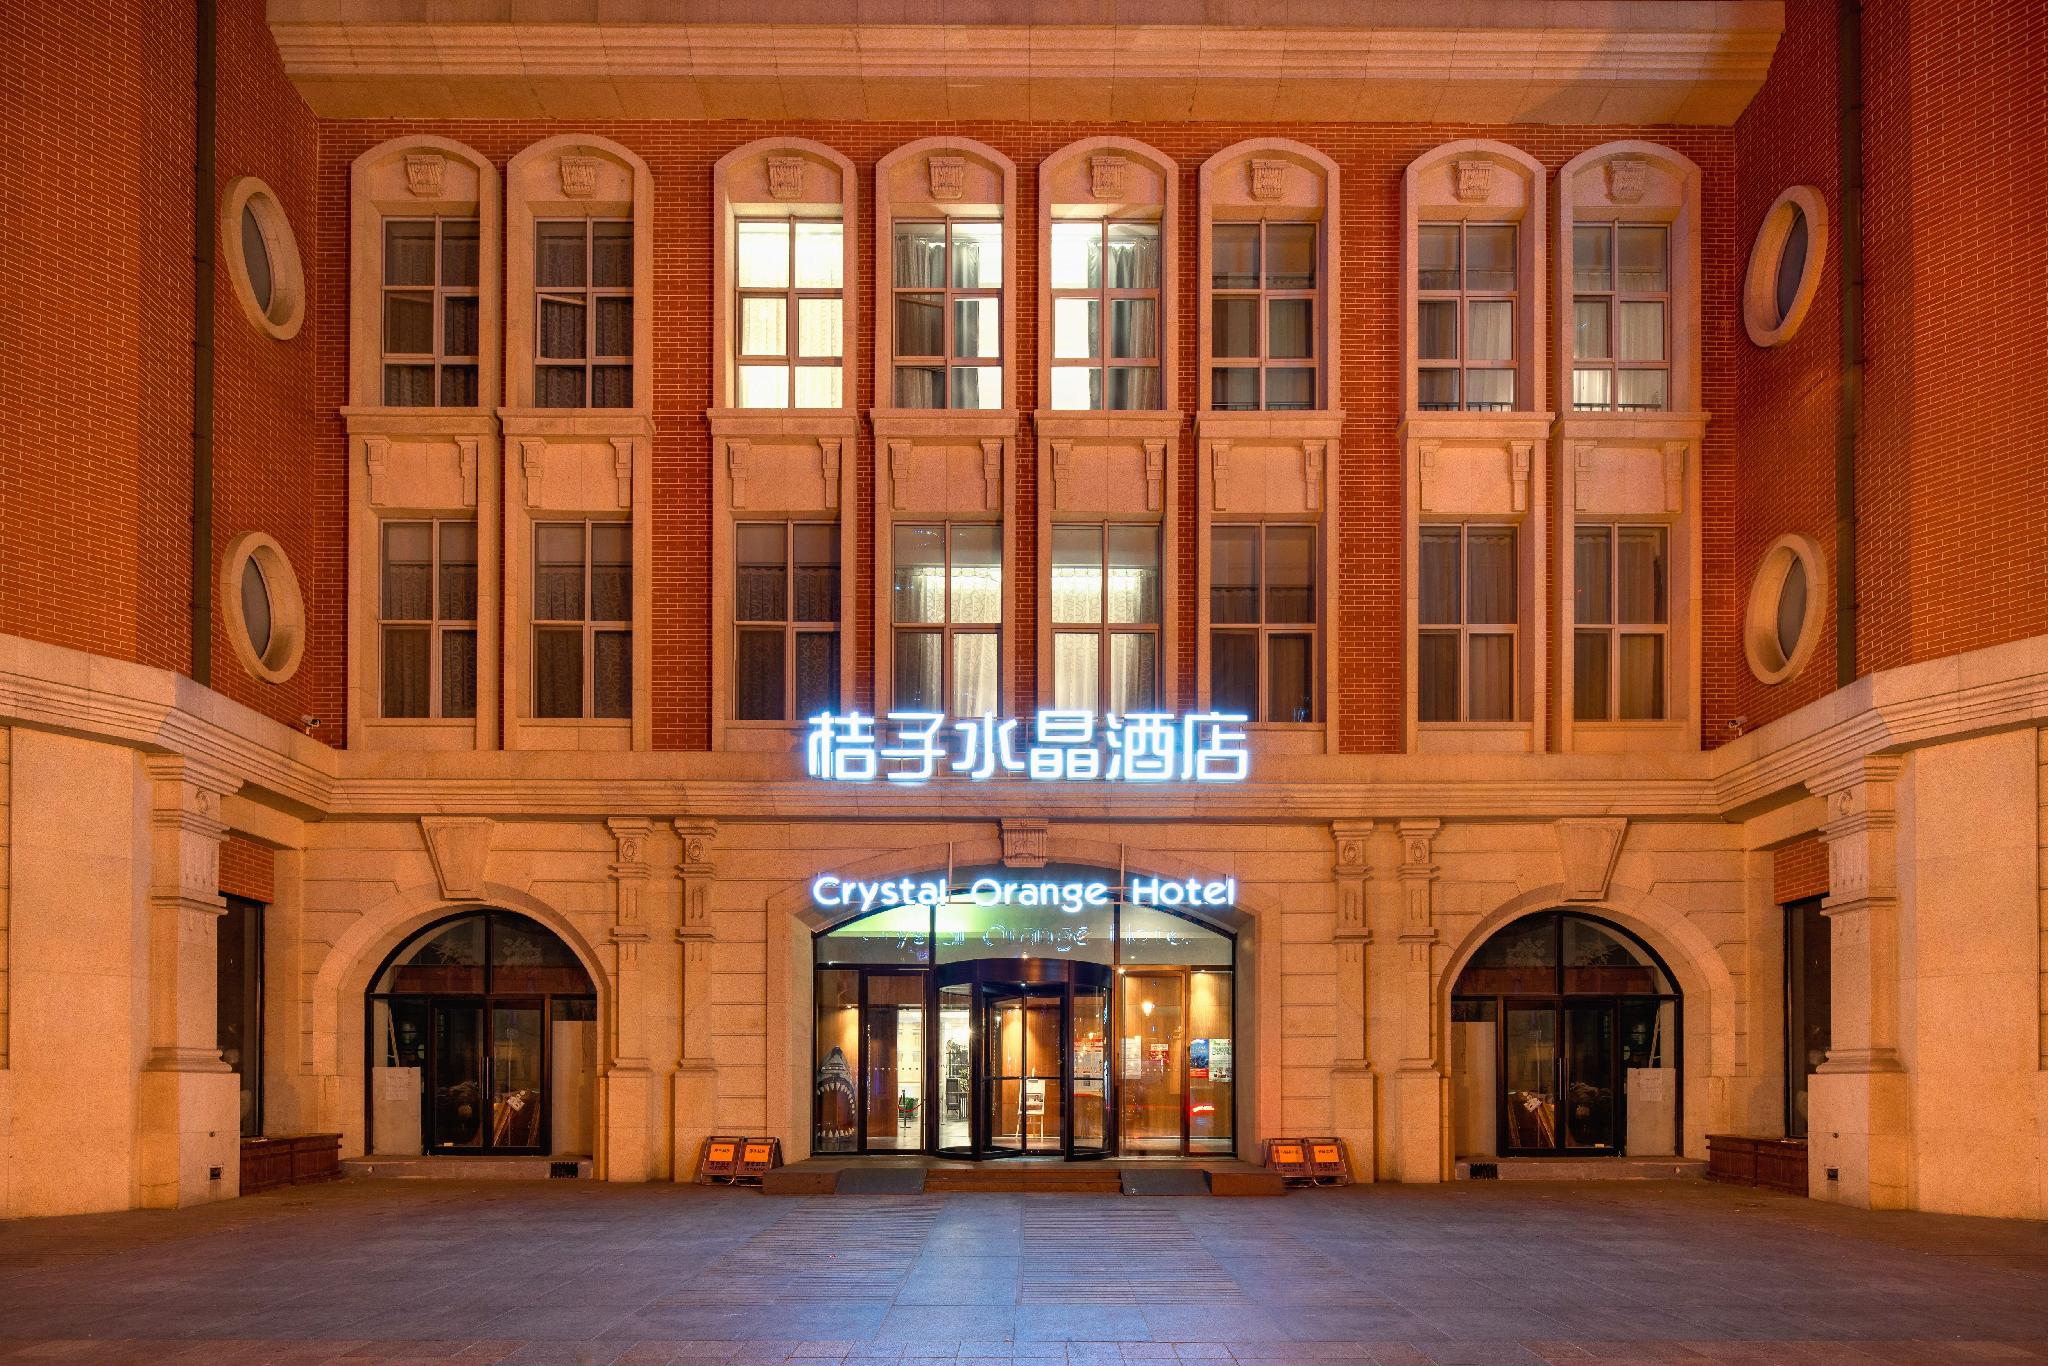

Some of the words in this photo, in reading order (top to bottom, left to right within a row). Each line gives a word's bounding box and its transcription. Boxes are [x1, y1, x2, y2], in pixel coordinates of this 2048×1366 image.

[808, 710, 1249, 781] 桔子水晶酒店
[812, 876, 947, 912] Crystal
[970, 877, 1108, 913] Orange
[1132, 877, 1235, 905] Hotel
